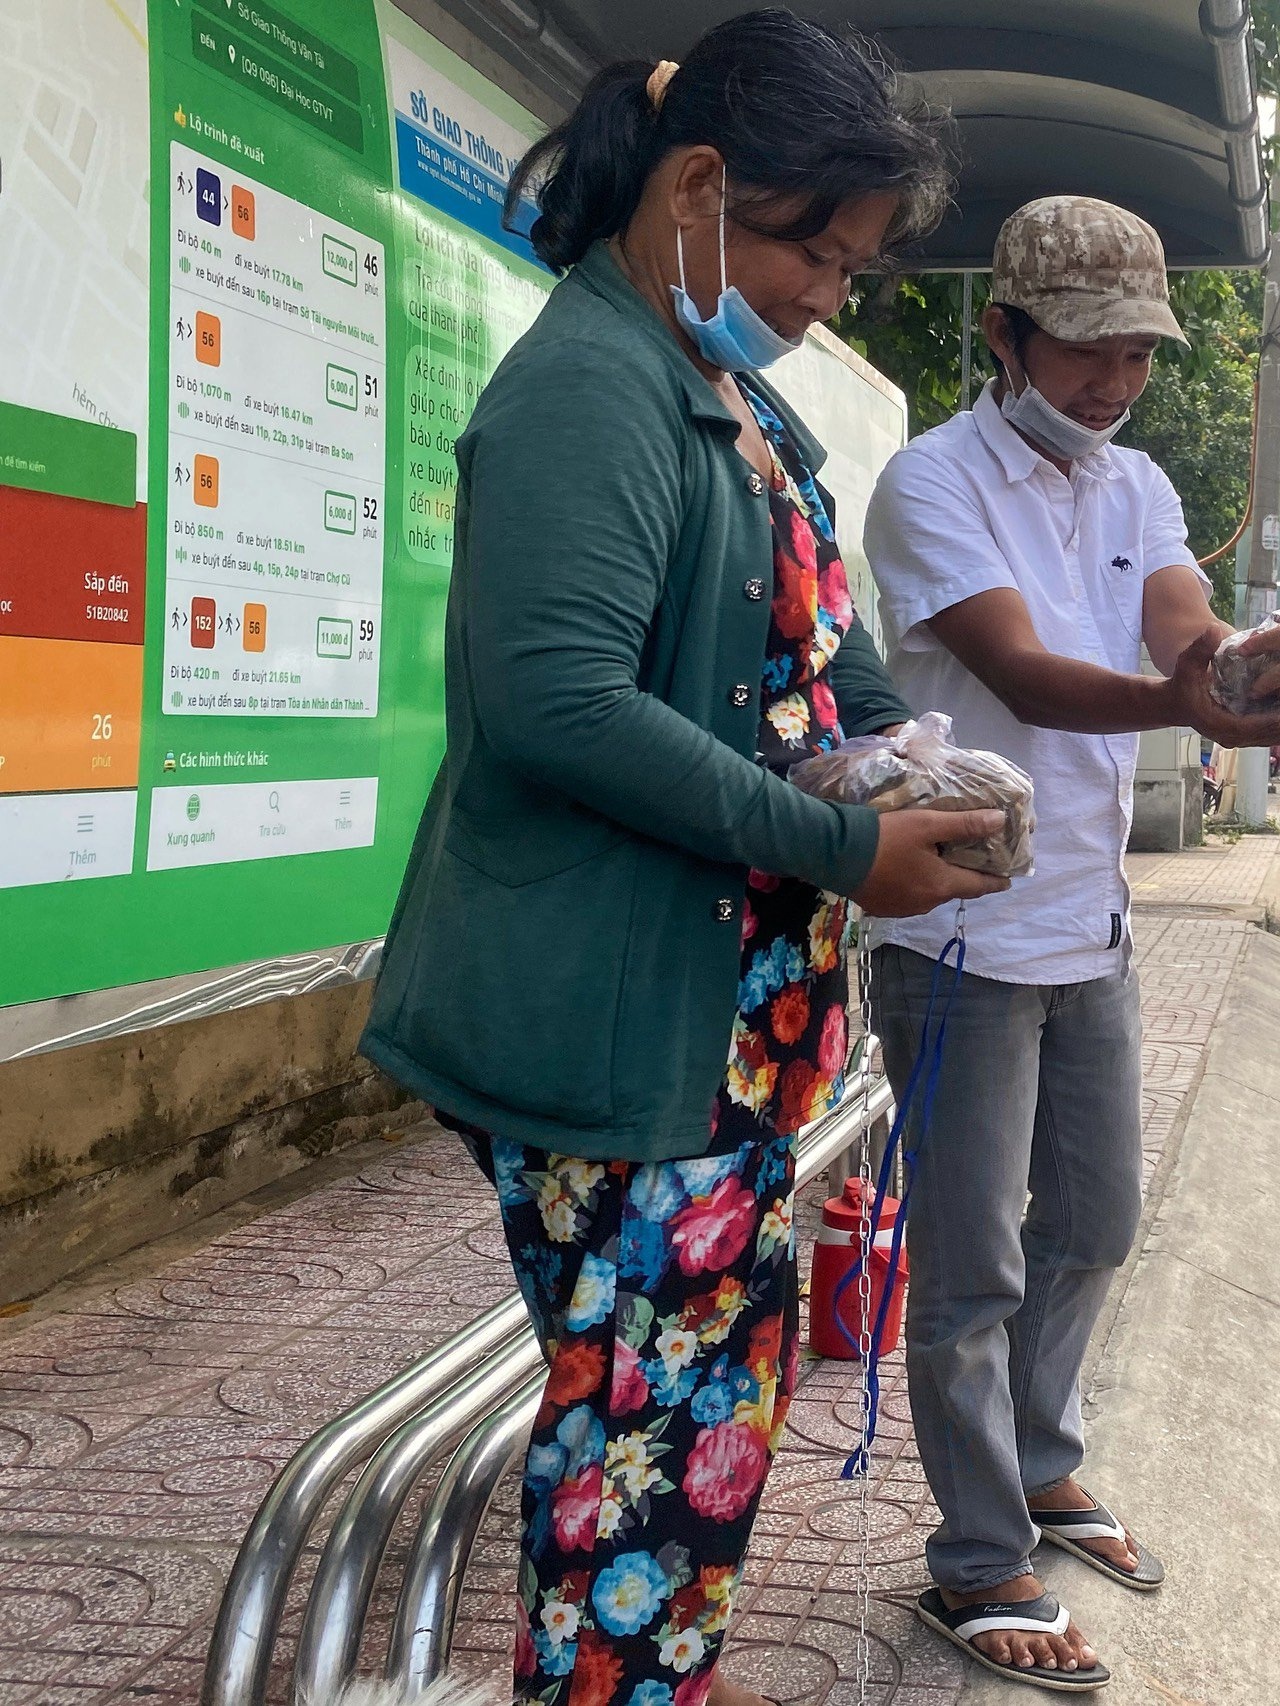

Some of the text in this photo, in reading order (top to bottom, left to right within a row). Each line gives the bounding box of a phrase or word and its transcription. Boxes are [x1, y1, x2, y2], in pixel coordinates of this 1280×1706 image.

[200, 32, 215, 51] ĐẾN
[238, 2, 249, 21] Sở
[251, 11, 270, 34] Giao
[271, 23, 297, 55] Thông
[299, 41, 312, 61] Vận
[242, 56, 333, 122] [Q9 096] Đại Học GTVT
[190, 113, 265, 165] Lộ trình đề xuất
[410, 89, 429, 123] SỞ
[432, 107, 462, 147] GIAO
[464, 130, 504, 176] THÔNG
[415, 136, 441, 166] Thành
[443, 155, 457, 176] phố
[460, 164, 470, 184] Hồ
[473, 173, 485, 193] Chí
[202, 189, 215, 206] 44
[238, 205, 249, 222] 56
[178, 229, 222, 258] Đi bộ 40 m
[327, 250, 348, 271] 12,000
[364, 253, 378, 277] 46
[235, 254, 304, 292] đi xe buýt 17.78 km
[416, 264, 432, 292] Tra
[364, 281, 379, 297] phút
[196, 267, 205, 279] xe
[207, 267, 224, 288] buýt
[225, 276, 240, 293] đến
[242, 286, 255, 299] sau
[257, 288, 271, 306] 16p
[273, 294, 281, 310] tại
[283, 300, 299, 317] trạm
[322, 317, 348, 334] nguyên
[202, 332, 214, 348] 56
[176, 374, 232, 402] Đi bộ 1,070 m
[330, 380, 348, 396] 6,000
[365, 374, 378, 399] 51
[244, 395, 313, 426] đi xe buýt 16.47 km
[364, 404, 379, 418] phút
[411, 390, 435, 420] giúp
[194, 411, 203, 422] xe
[205, 411, 222, 428] buýt
[224, 416, 239, 431] đến
[240, 423, 254, 435] sau
[291, 434, 304, 450] 31p
[305, 438, 314, 454] tại
[315, 442, 330, 456] trạm
[331, 445, 340, 457] Ba
[341, 448, 354, 461] Son
[201, 474, 212, 489] 56
[410, 461, 424, 480] xe
[329, 506, 347, 520] 6,000
[363, 497, 377, 520] 52
[410, 490, 431, 516] đến
[174, 520, 224, 541] Đi bộ 850 m
[363, 526, 377, 540] phút
[409, 525, 436, 551] nhắc
[237, 531, 305, 554] đi xe buýt 18.51 km
[191, 554, 201, 565] xe
[203, 553, 220, 569] buýt
[222, 554, 236, 570] đến
[238, 560, 251, 572] sau
[285, 565, 299, 580] 24p
[300, 569, 309, 583] tại
[310, 571, 325, 584] trạm
[326, 573, 340, 586] Chợ
[84, 571, 128, 596] Sắp đến
[86, 605, 128, 622] 51B20842
[195, 616, 212, 631] 152
[249, 621, 260, 635] 56
[321, 631, 343, 646] 11,000
[359, 619, 374, 642] 59
[358, 648, 373, 662] phút
[170, 665, 220, 682] Đi bộ 420 m
[232, 667, 301, 686] đi xe buýt 21.65 km
[187, 696, 197, 707] xe
[198, 693, 216, 709] buýt
[217, 691, 232, 708] đến
[234, 697, 247, 708] sau
[248, 696, 258, 711] 8p
[260, 696, 269, 710] tại
[270, 697, 286, 710] trạm
[91, 714, 112, 740] 26
[180, 750, 268, 767] Các hình thức khác
[167, 829, 215, 847] Xung quanh
